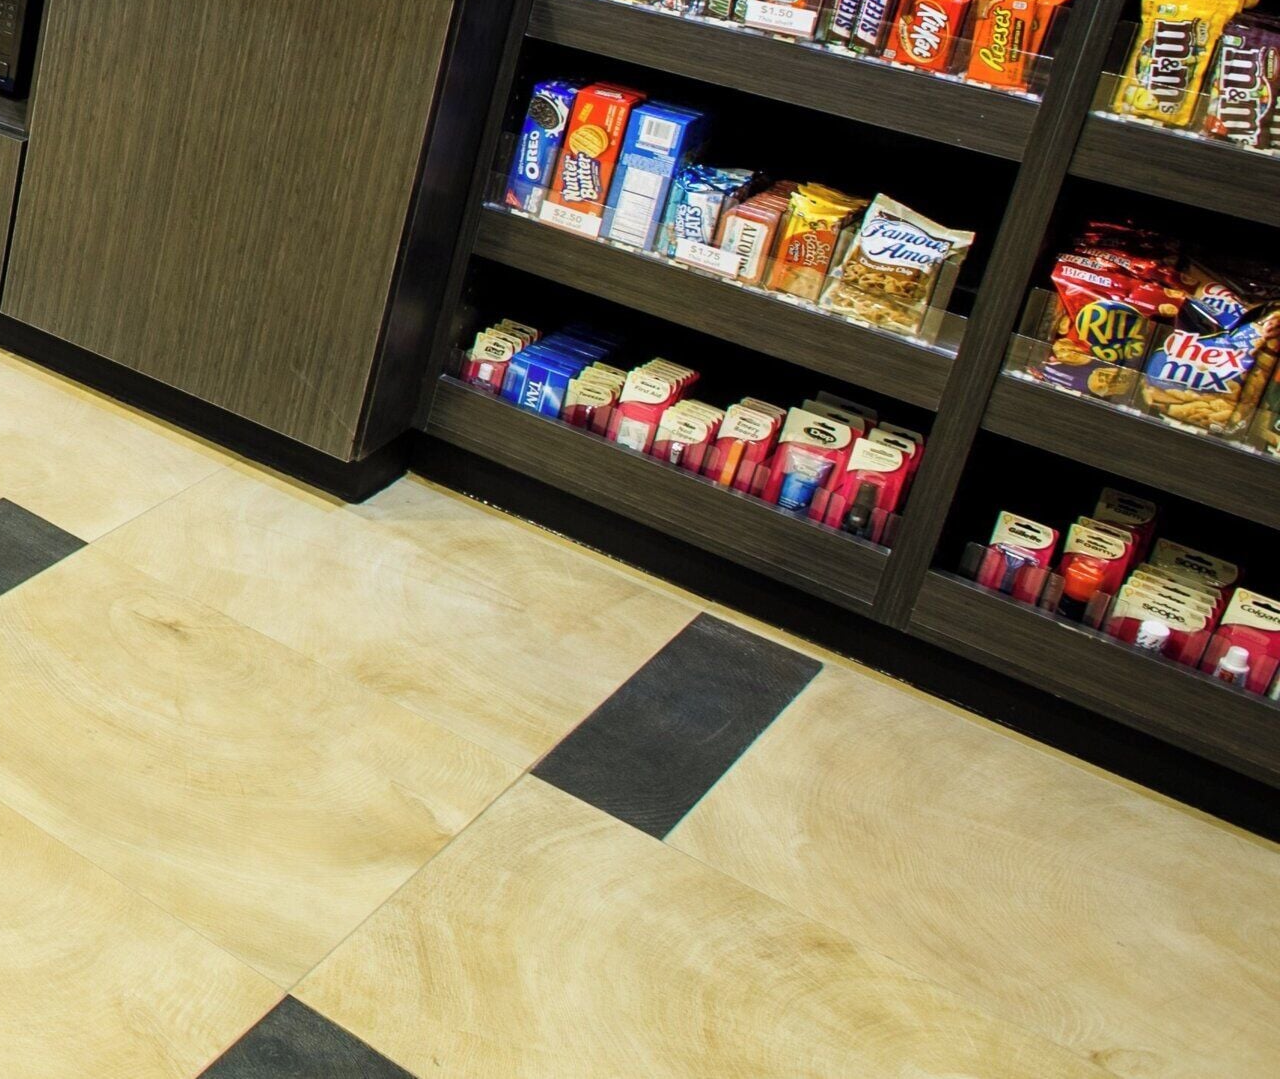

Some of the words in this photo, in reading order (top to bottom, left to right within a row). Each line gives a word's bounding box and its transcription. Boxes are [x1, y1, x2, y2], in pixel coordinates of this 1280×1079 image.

[760, 4, 794, 19] $1.50
[525, 130, 541, 181] OREO
[561, 154, 580, 202] Nutter
[577, 151, 598, 201] Butter
[553, 208, 582, 224] $2.50
[802, 230, 818, 267] Batch
[860, 220, 951, 254] Famous
[690, 244, 721, 261] $1.75
[870, 241, 940, 267] Amos
[859, 257, 894, 273] Chocolate
[895, 265, 915, 276] Chip
[1061, 265, 1086, 282] BIG
[1087, 271, 1112, 288] BAG
[1077, 303, 1144, 344] RITZ
[1163, 329, 1246, 368] Chex
[810, 427, 834, 443] Dep
[1008, 526, 1044, 544] Gillette
[1075, 537, 1118, 559] Foamy
[1142, 602, 1186, 624] scope
